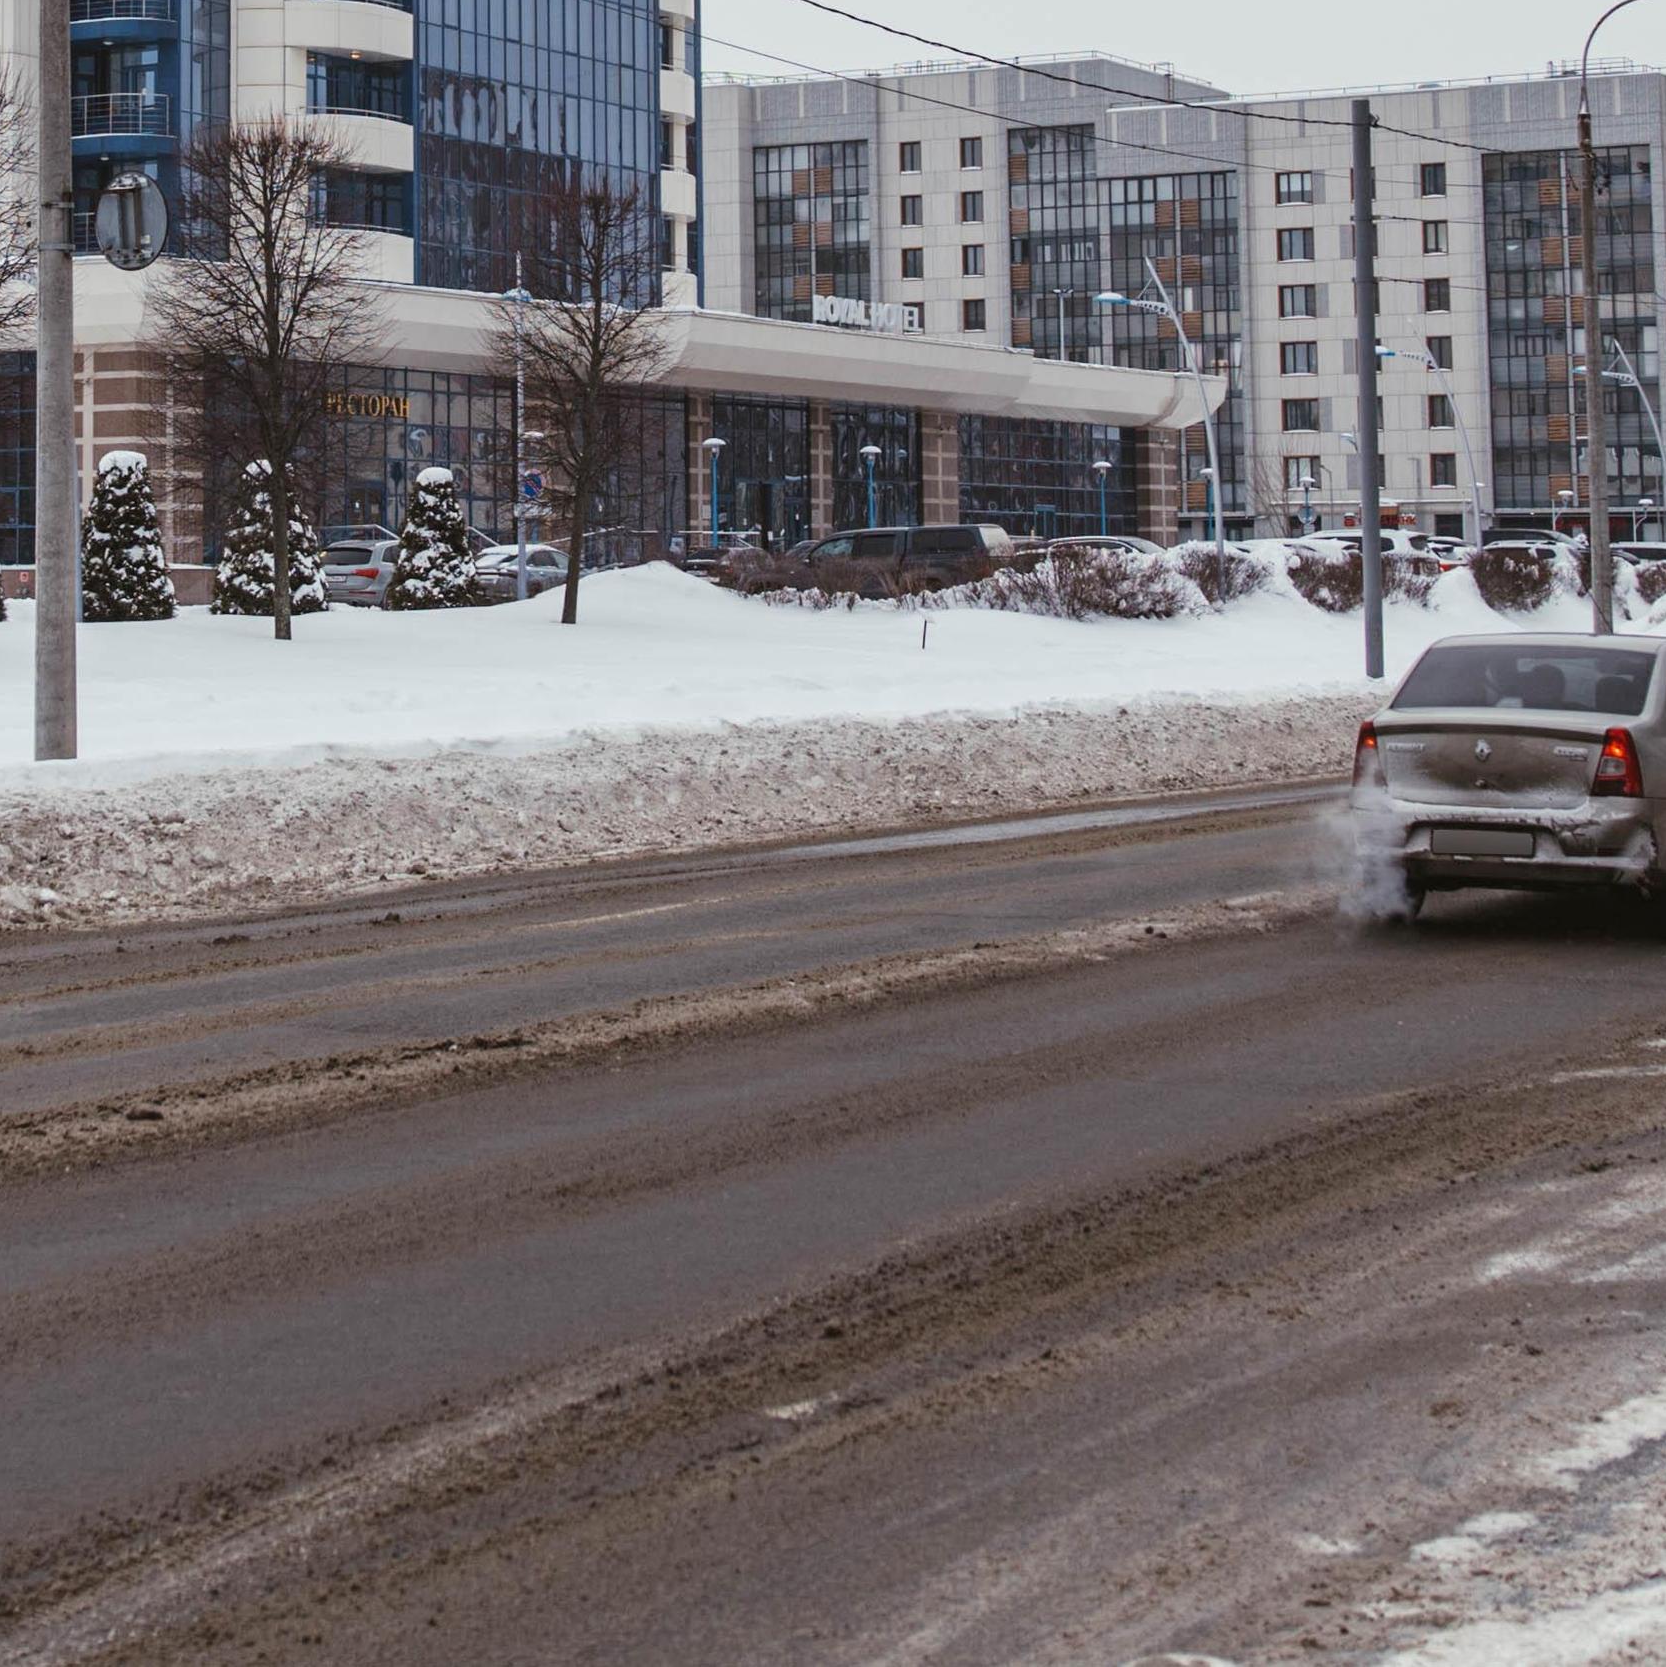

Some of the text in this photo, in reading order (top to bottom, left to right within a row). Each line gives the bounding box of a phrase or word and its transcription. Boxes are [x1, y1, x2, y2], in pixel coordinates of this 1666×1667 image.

[812, 294, 924, 333] ROYAL HOTEL
[326, 392, 410, 418] РЕСТОРАН
